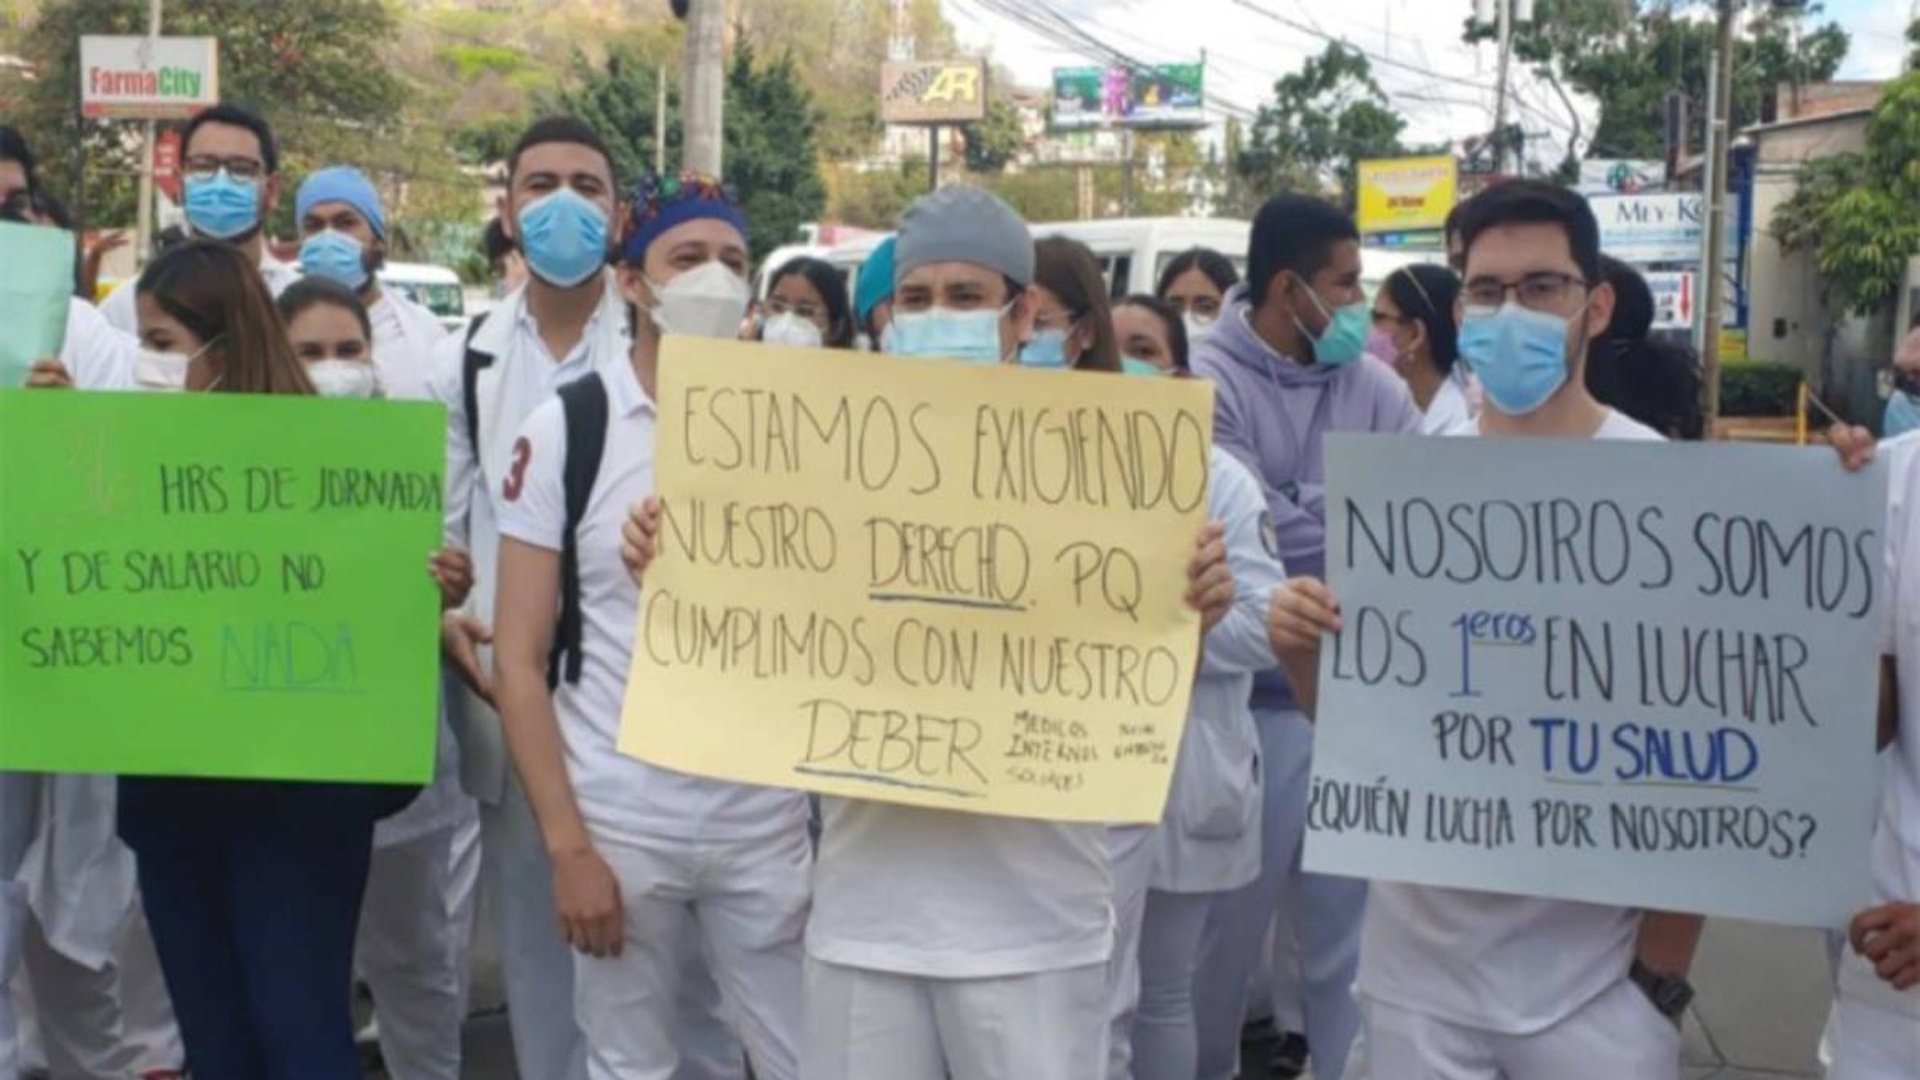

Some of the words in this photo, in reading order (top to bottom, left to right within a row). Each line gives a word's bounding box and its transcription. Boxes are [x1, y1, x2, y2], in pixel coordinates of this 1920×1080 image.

[89, 66, 202, 98] FarmaCity
[159, 463, 229, 514] HRS
[246, 467, 297, 512] DE
[311, 466, 443, 513] JORNADA
[502, 435, 532, 502] 3
[684, 385, 941, 495] ESTAMOS
[972, 402, 1209, 513] EXIGIENDO
[18, 548, 40, 594] Y
[64, 551, 111, 592] DE
[124, 549, 261, 592] SALARIO
[282, 552, 325, 593] NO
[657, 496, 836, 573] NUESTRO
[1056, 540, 1143, 623] PQ
[1346, 497, 1672, 590] NOSOTROS
[1695, 511, 1875, 618] SOMOS
[22, 625, 193, 668] SABEMOS
[220, 621, 360, 687] NADA
[645, 588, 875, 685] CUMPLIMOS
[895, 617, 978, 691] CON
[1000, 636, 1179, 708] NUESTRO
[1332, 605, 1427, 688] LOS
[1448, 609, 1537, 697] 1eros
[1543, 616, 1614, 701] EN
[1638, 625, 1818, 727] LUCHAR
[799, 698, 989, 784] DEBER
[1432, 710, 1515, 766] POR
[1530, 717, 1600, 775] TU
[1614, 721, 1759, 783] SALUD
[1307, 776, 1410, 837] ¿QUIÉN
[1425, 795, 1515, 850] LUCHA
[1532, 799, 1597, 850] POR
[1611, 802, 1819, 861] NOSOTROS?
